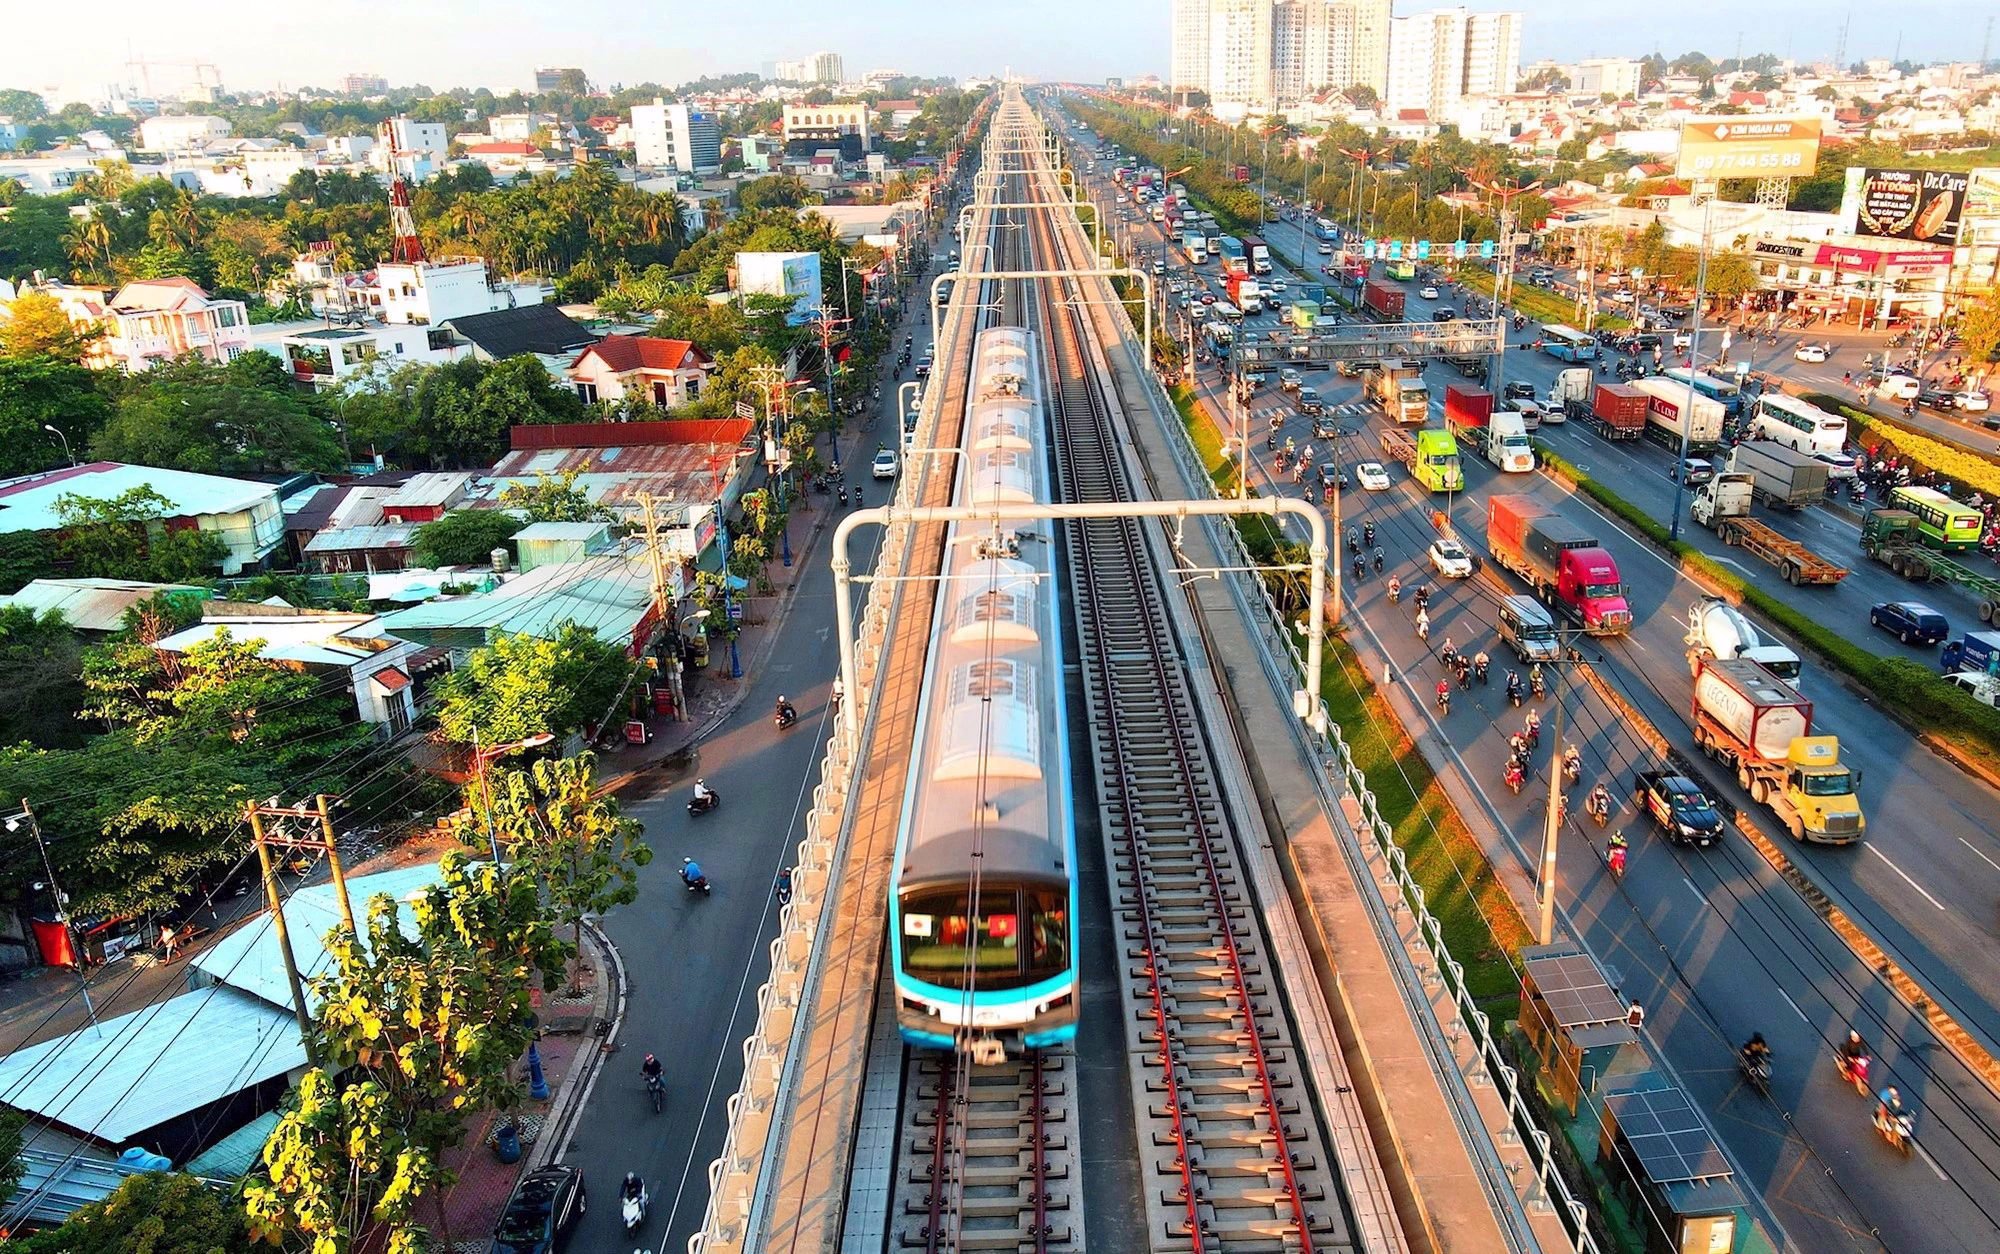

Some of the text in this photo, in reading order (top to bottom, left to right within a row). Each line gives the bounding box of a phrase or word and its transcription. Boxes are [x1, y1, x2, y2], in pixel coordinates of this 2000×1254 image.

[1719, 155, 1736, 168] 77
[1738, 154, 1757, 167] 44
[1783, 152, 1801, 166] 88
[1923, 172, 1968, 192] Dr.Care
[1755, 241, 1804, 257] BRIDGESTONE
[1654, 399, 1664, 412] K
[1661, 406, 1677, 419] LINE
[1707, 685, 1738, 716] LEGEND
